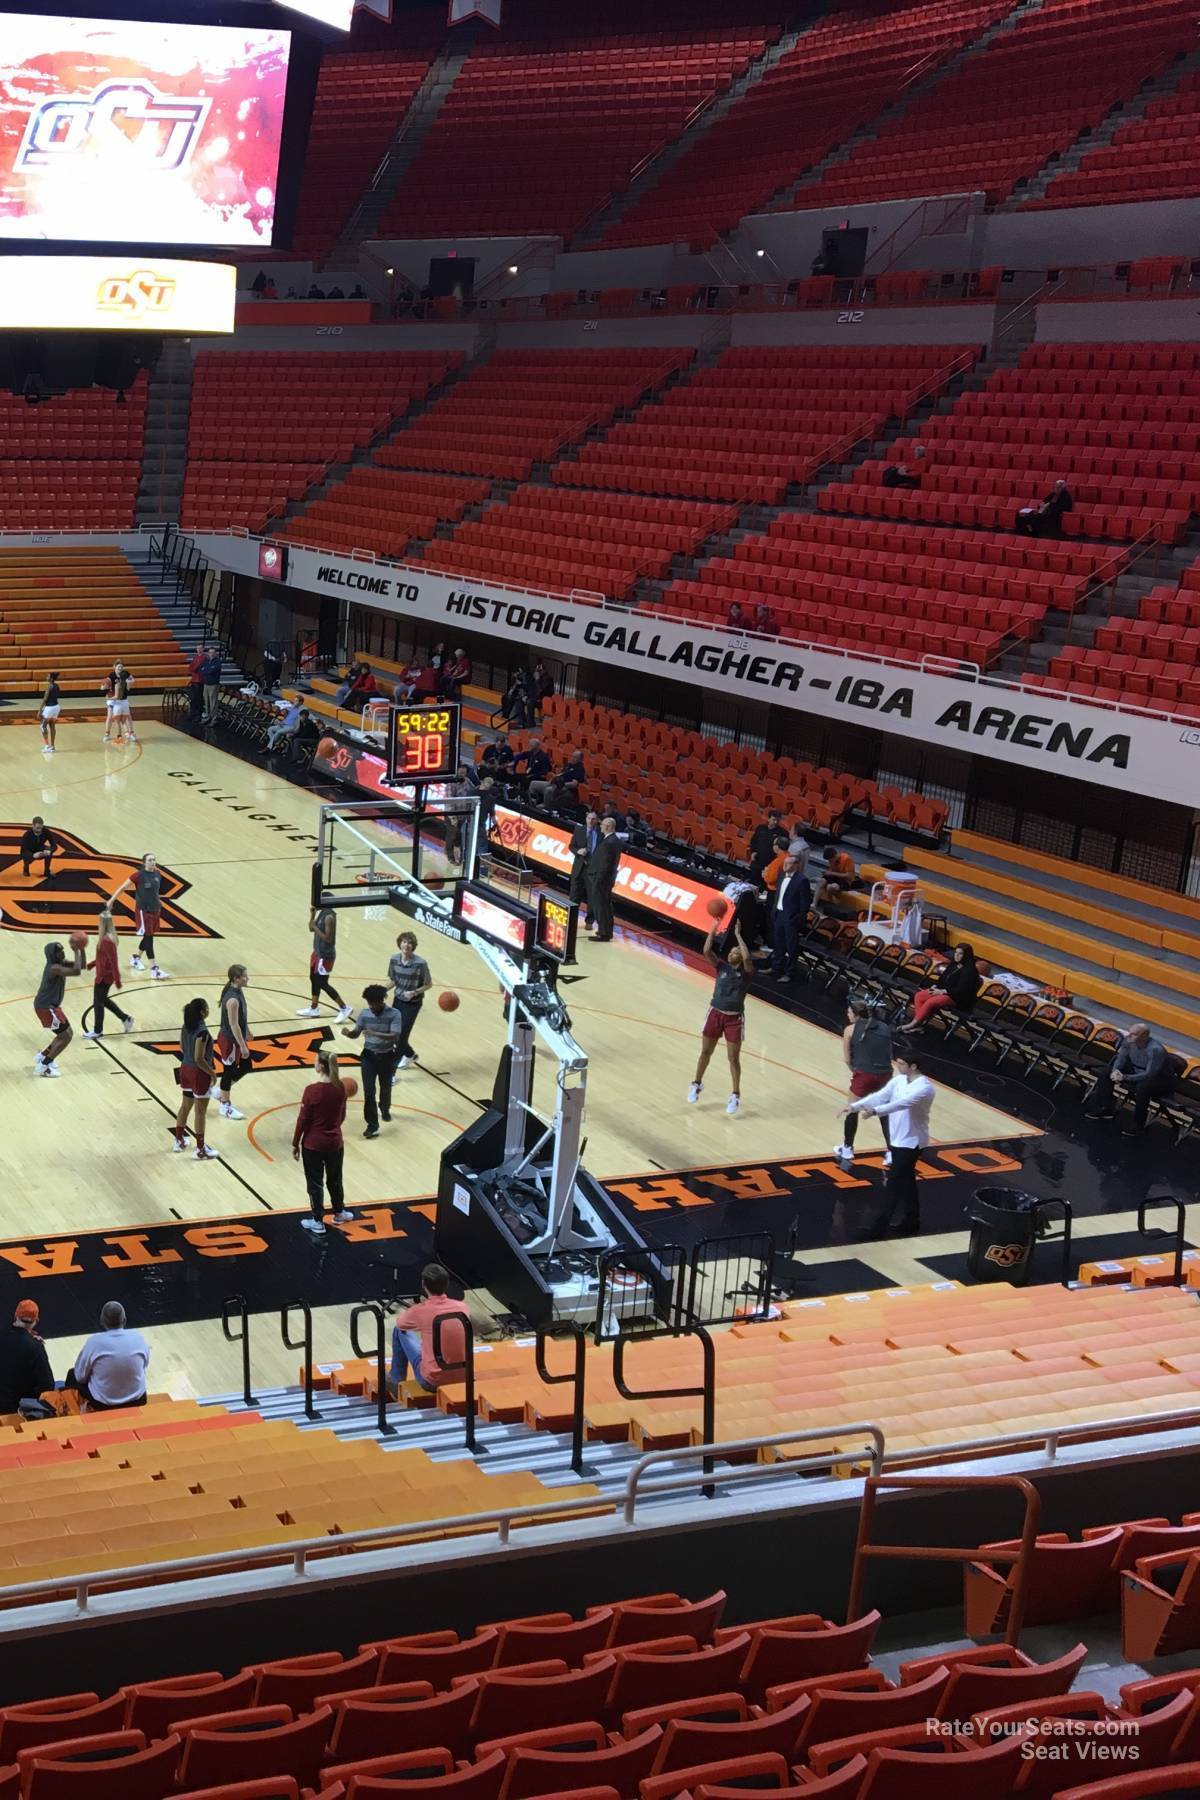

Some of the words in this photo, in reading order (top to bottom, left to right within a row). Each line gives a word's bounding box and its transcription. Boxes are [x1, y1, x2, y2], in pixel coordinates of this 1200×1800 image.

[13, 77, 213, 174] OSU
[97, 270, 176, 319] OSU
[838, 311, 864, 323] 212
[317, 566, 392, 596] WELCOME
[396, 582, 420, 602] TO
[446, 591, 576, 640] HISTORIC
[934, 700, 1132, 770] ARENA
[400, 712, 449, 733] 59:22
[405, 734, 442, 770] 30
[500, 818, 533, 845] OSU
[630, 869, 698, 912] STATE
[546, 921, 564, 949] 30
[984, 1244, 1031, 1267] OSU
